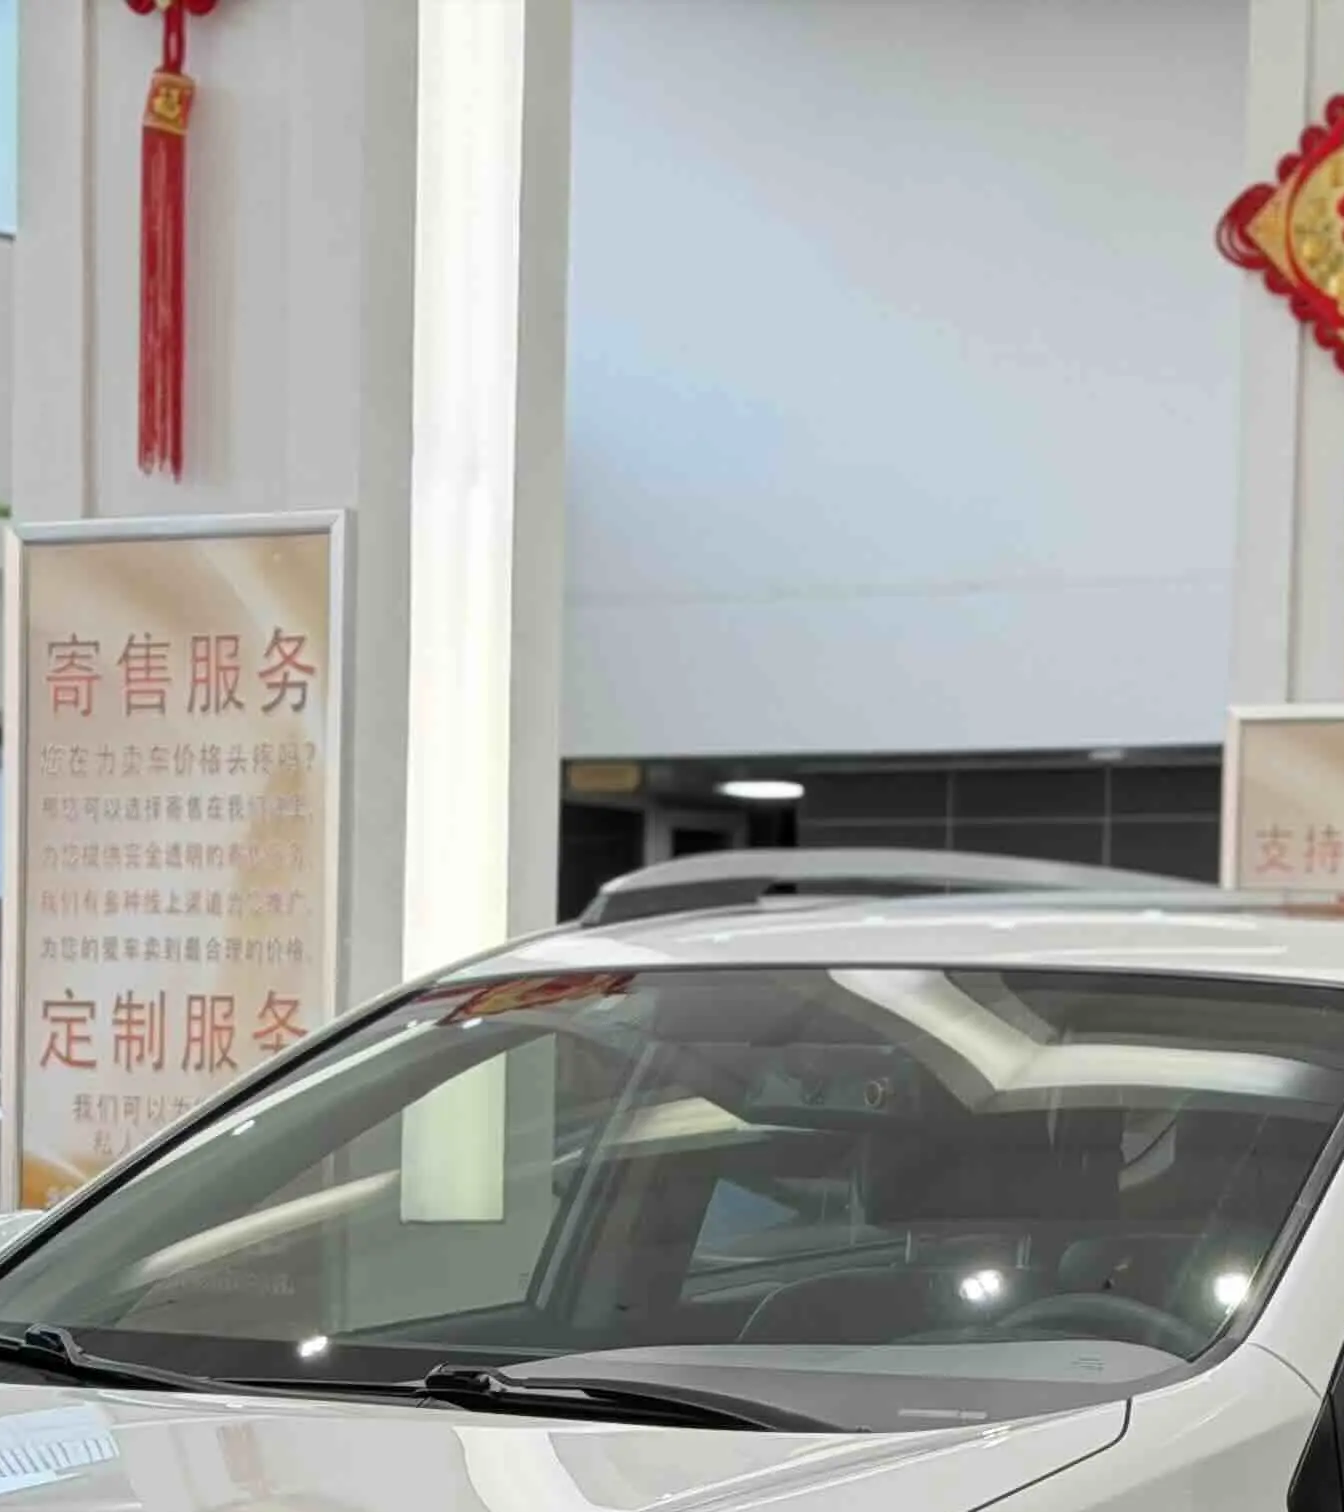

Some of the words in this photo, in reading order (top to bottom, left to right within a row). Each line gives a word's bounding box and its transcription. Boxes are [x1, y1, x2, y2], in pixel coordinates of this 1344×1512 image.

[45, 626, 316, 718] 寄售服务
[39, 987, 309, 1074] 定制服务
